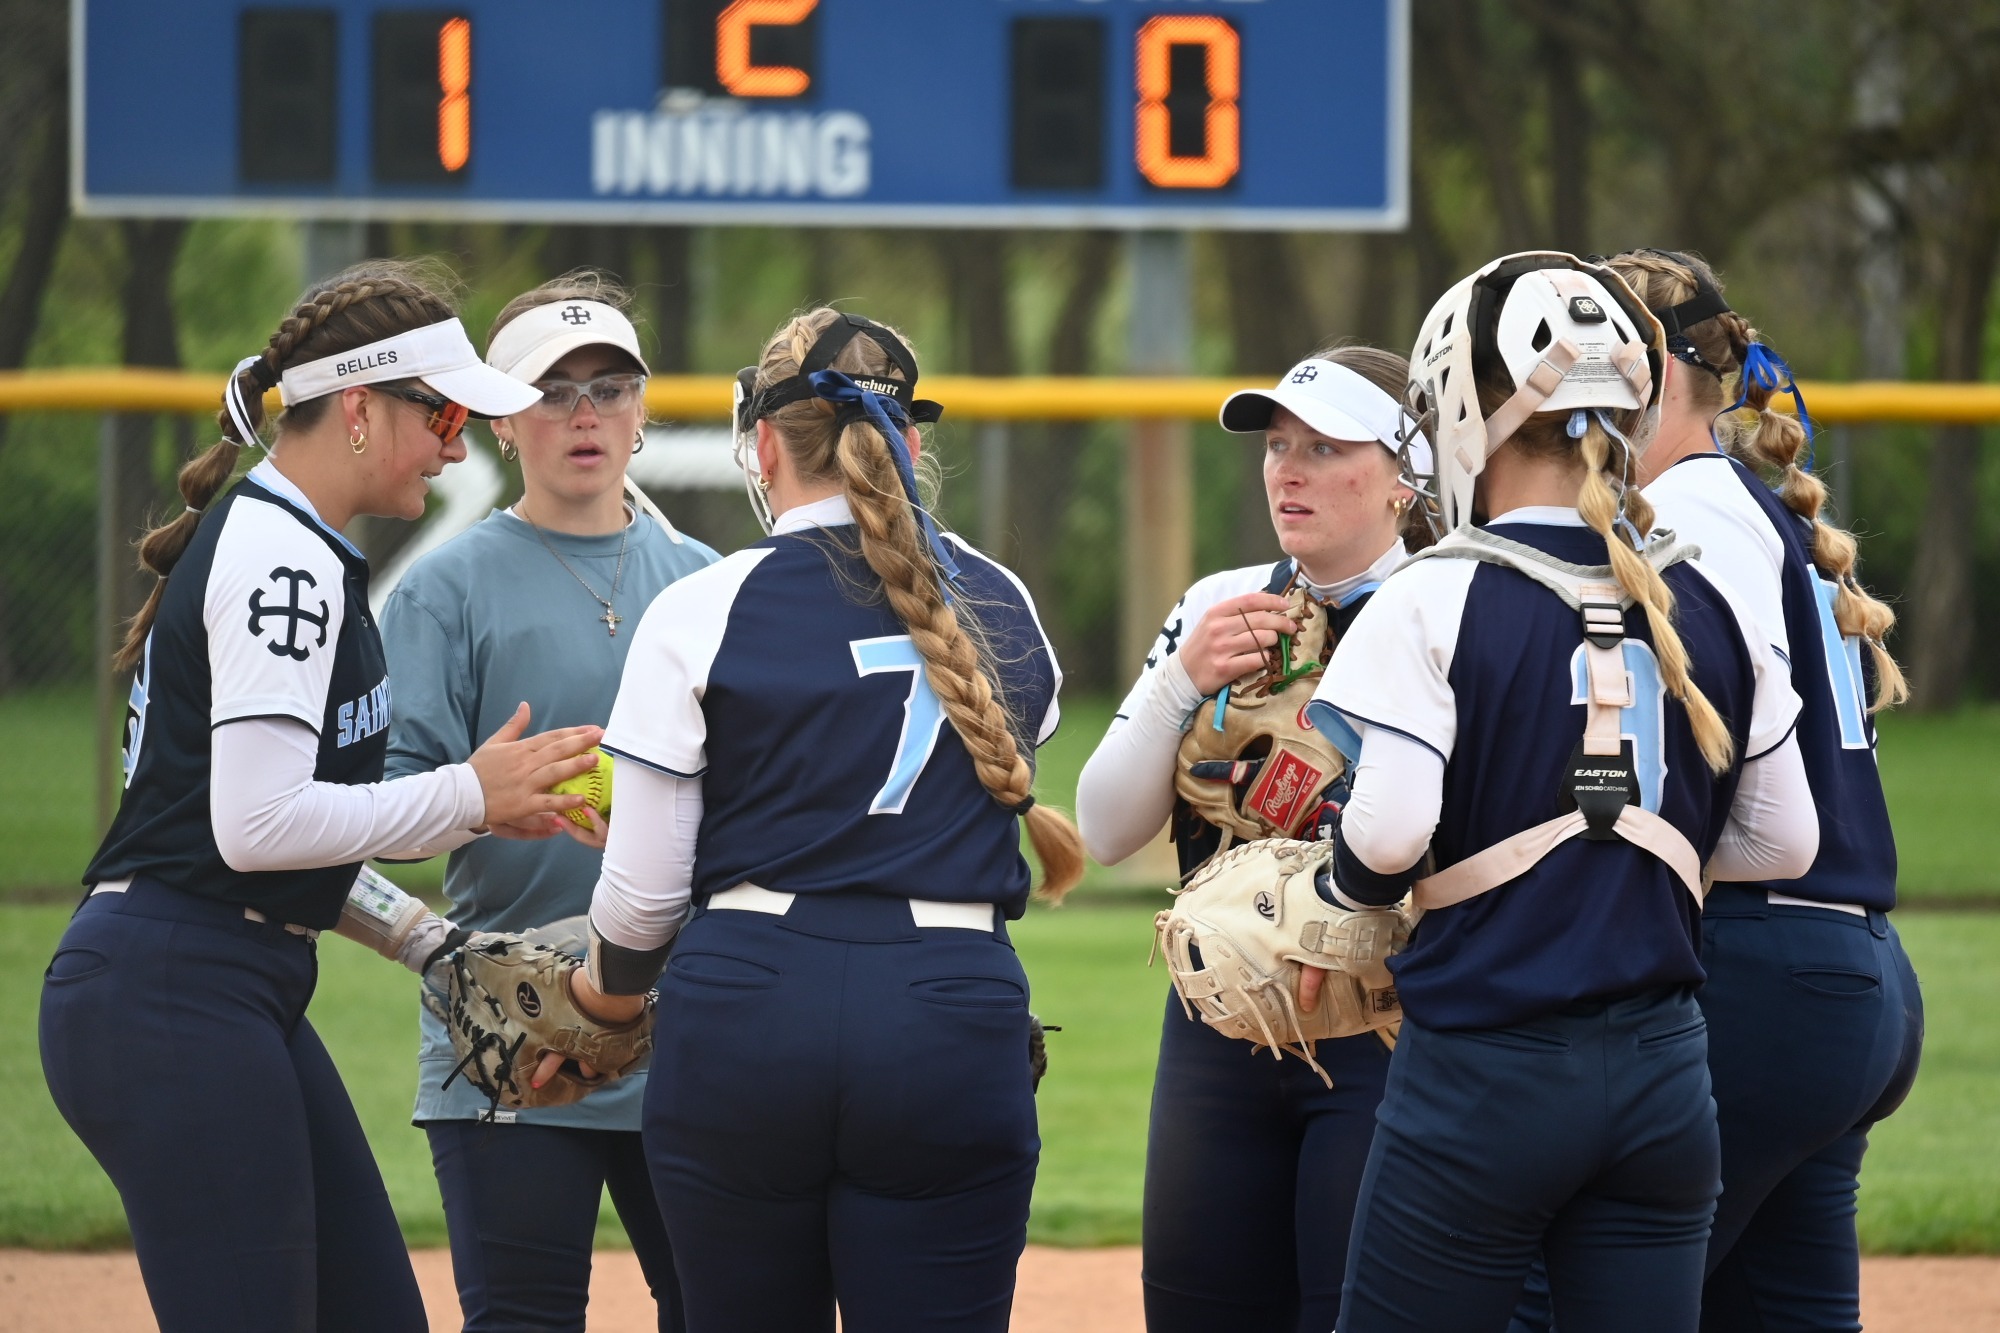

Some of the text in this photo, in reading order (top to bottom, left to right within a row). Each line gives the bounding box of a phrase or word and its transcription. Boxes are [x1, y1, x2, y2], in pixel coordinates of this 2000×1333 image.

[439, 16, 471, 172] 1
[1135, 14, 1239, 188] 0
[592, 110, 871, 197] INNING
[336, 350, 398, 377] BELLES
[1427, 343, 1453, 367] EASTON
[337, 674, 392, 749] SAIN
[849, 634, 948, 815] 7
[1265, 762, 1299, 817] Rawlings
[1574, 769, 1628, 778] EASTON
